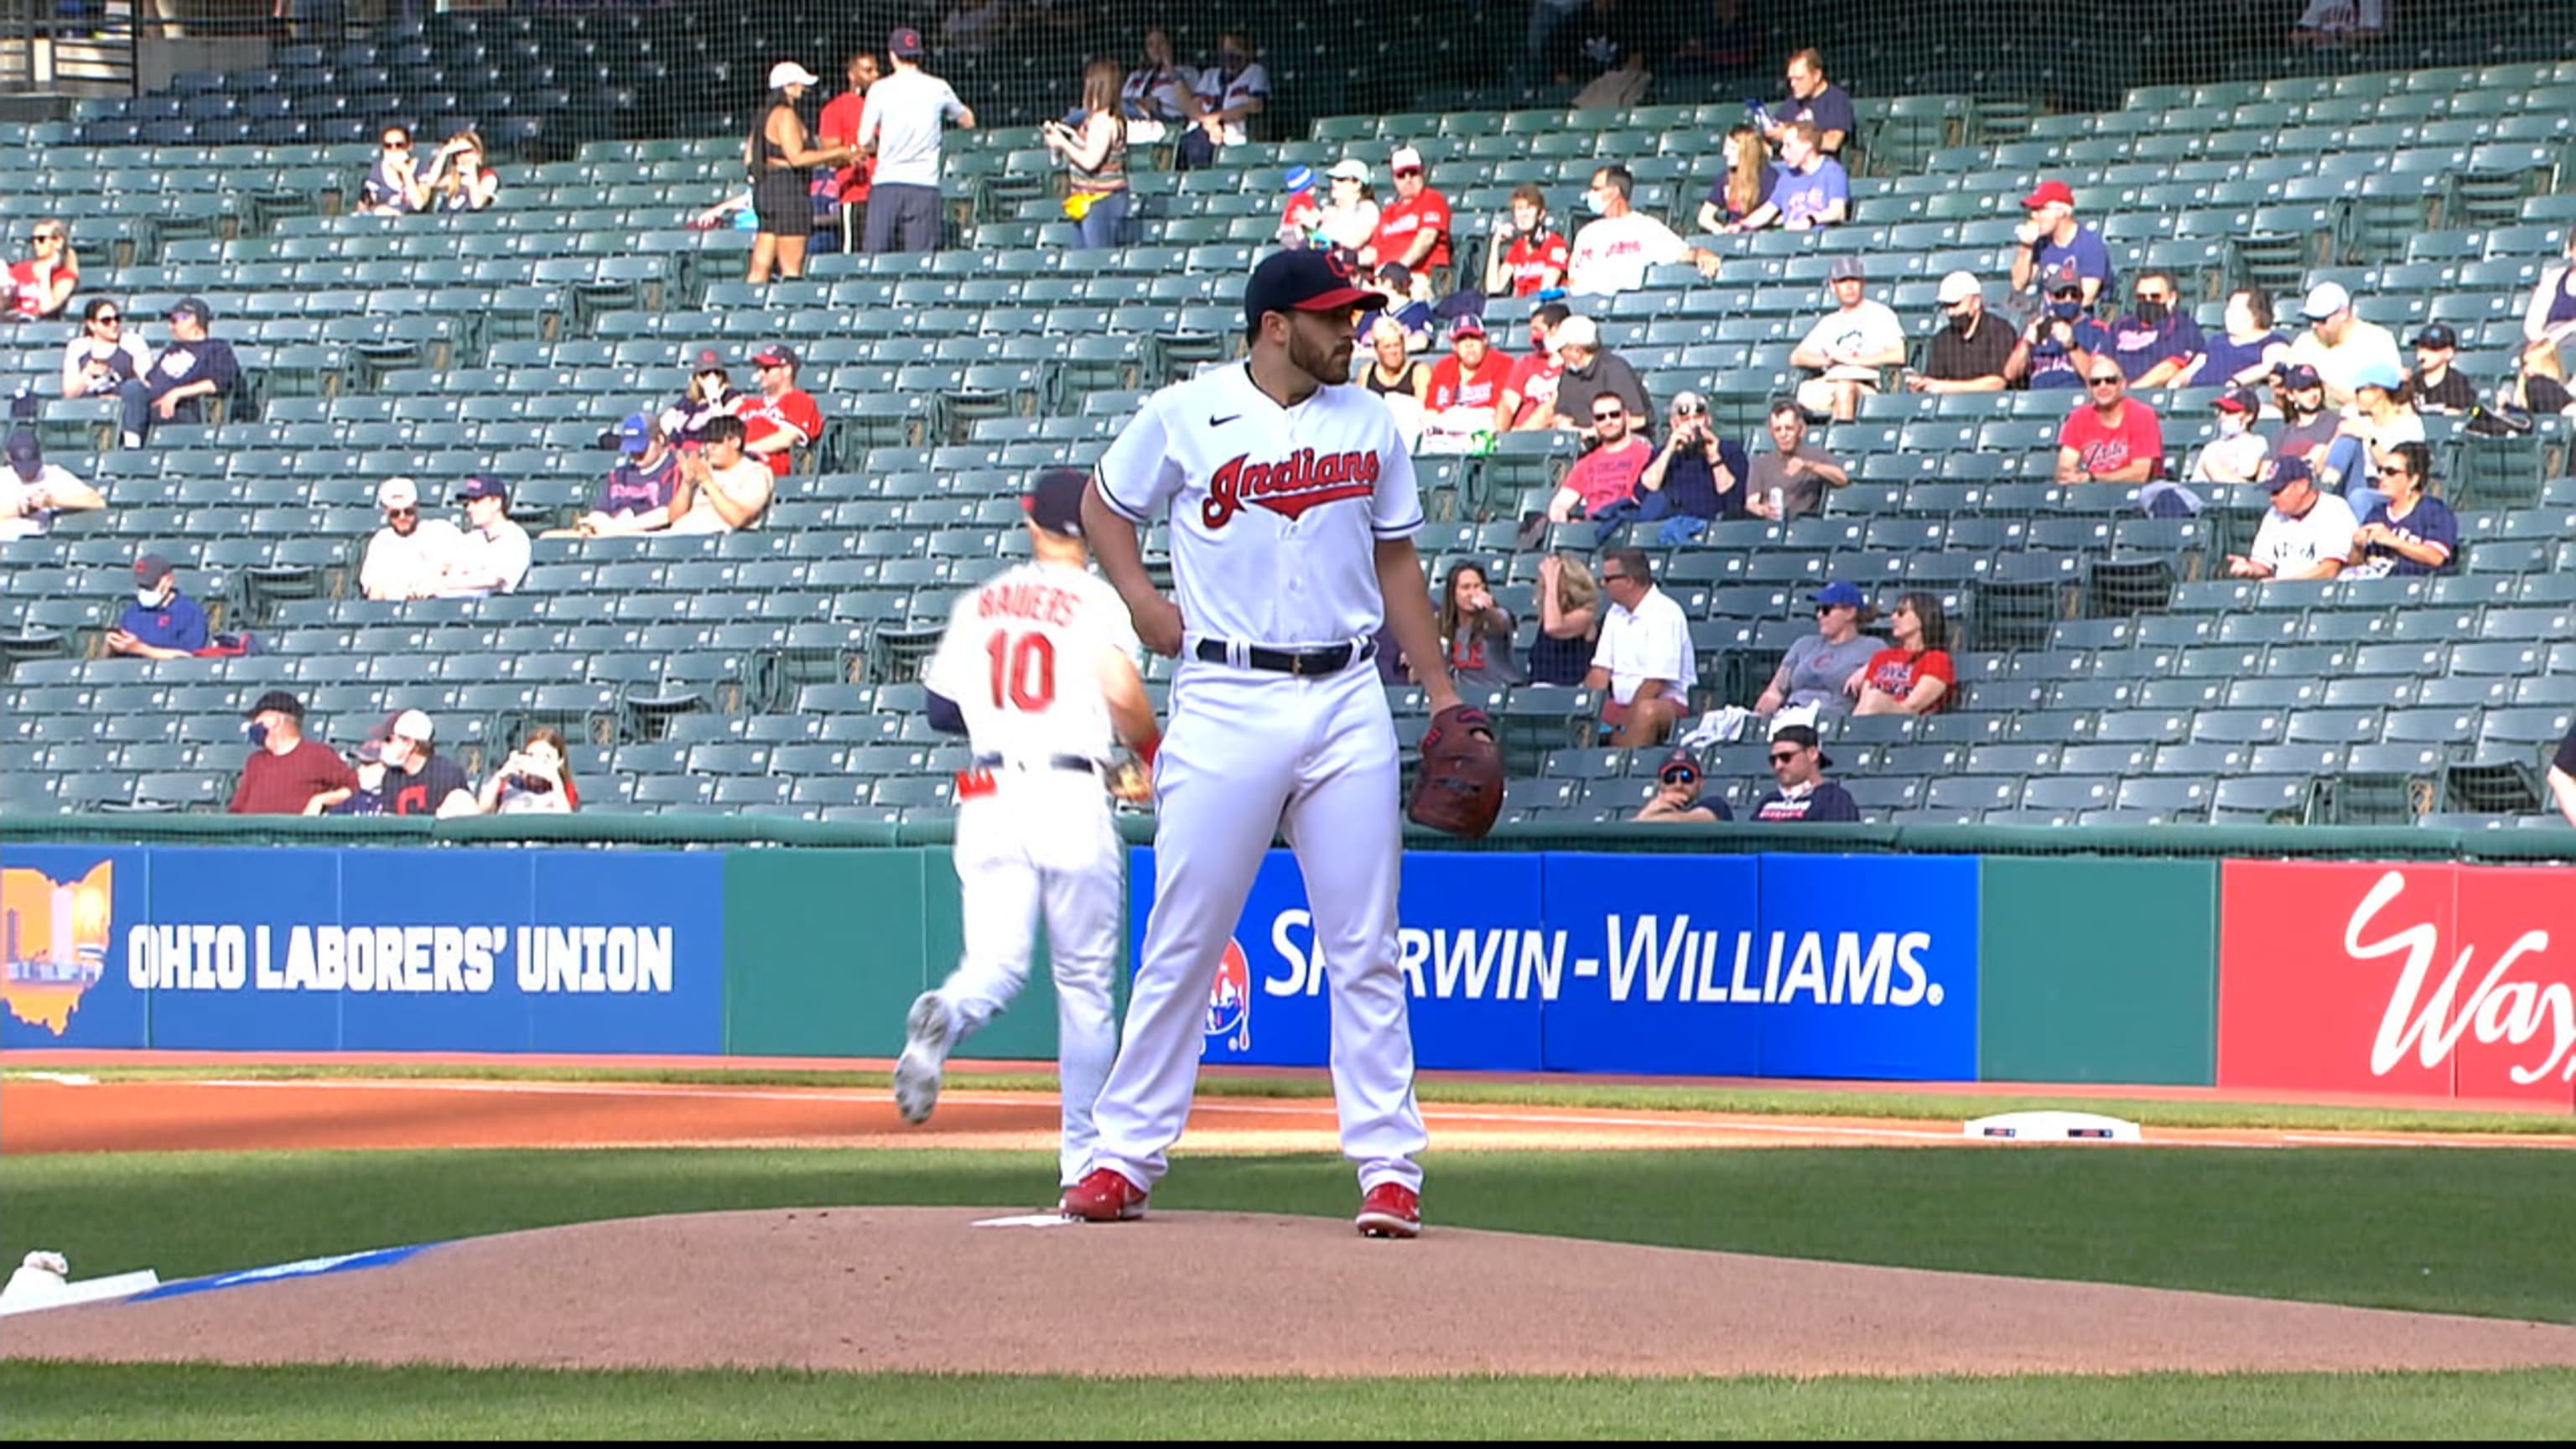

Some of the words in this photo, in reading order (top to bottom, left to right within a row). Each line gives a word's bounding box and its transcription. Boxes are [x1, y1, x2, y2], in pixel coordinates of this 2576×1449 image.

[1202, 447, 1381, 531] Indians
[977, 584, 1082, 629] BAUERS
[985, 628, 1055, 714] 10
[128, 925, 245, 989] OHIO
[255, 926, 507, 992] LABORERS'
[517, 927, 673, 993] UNION
